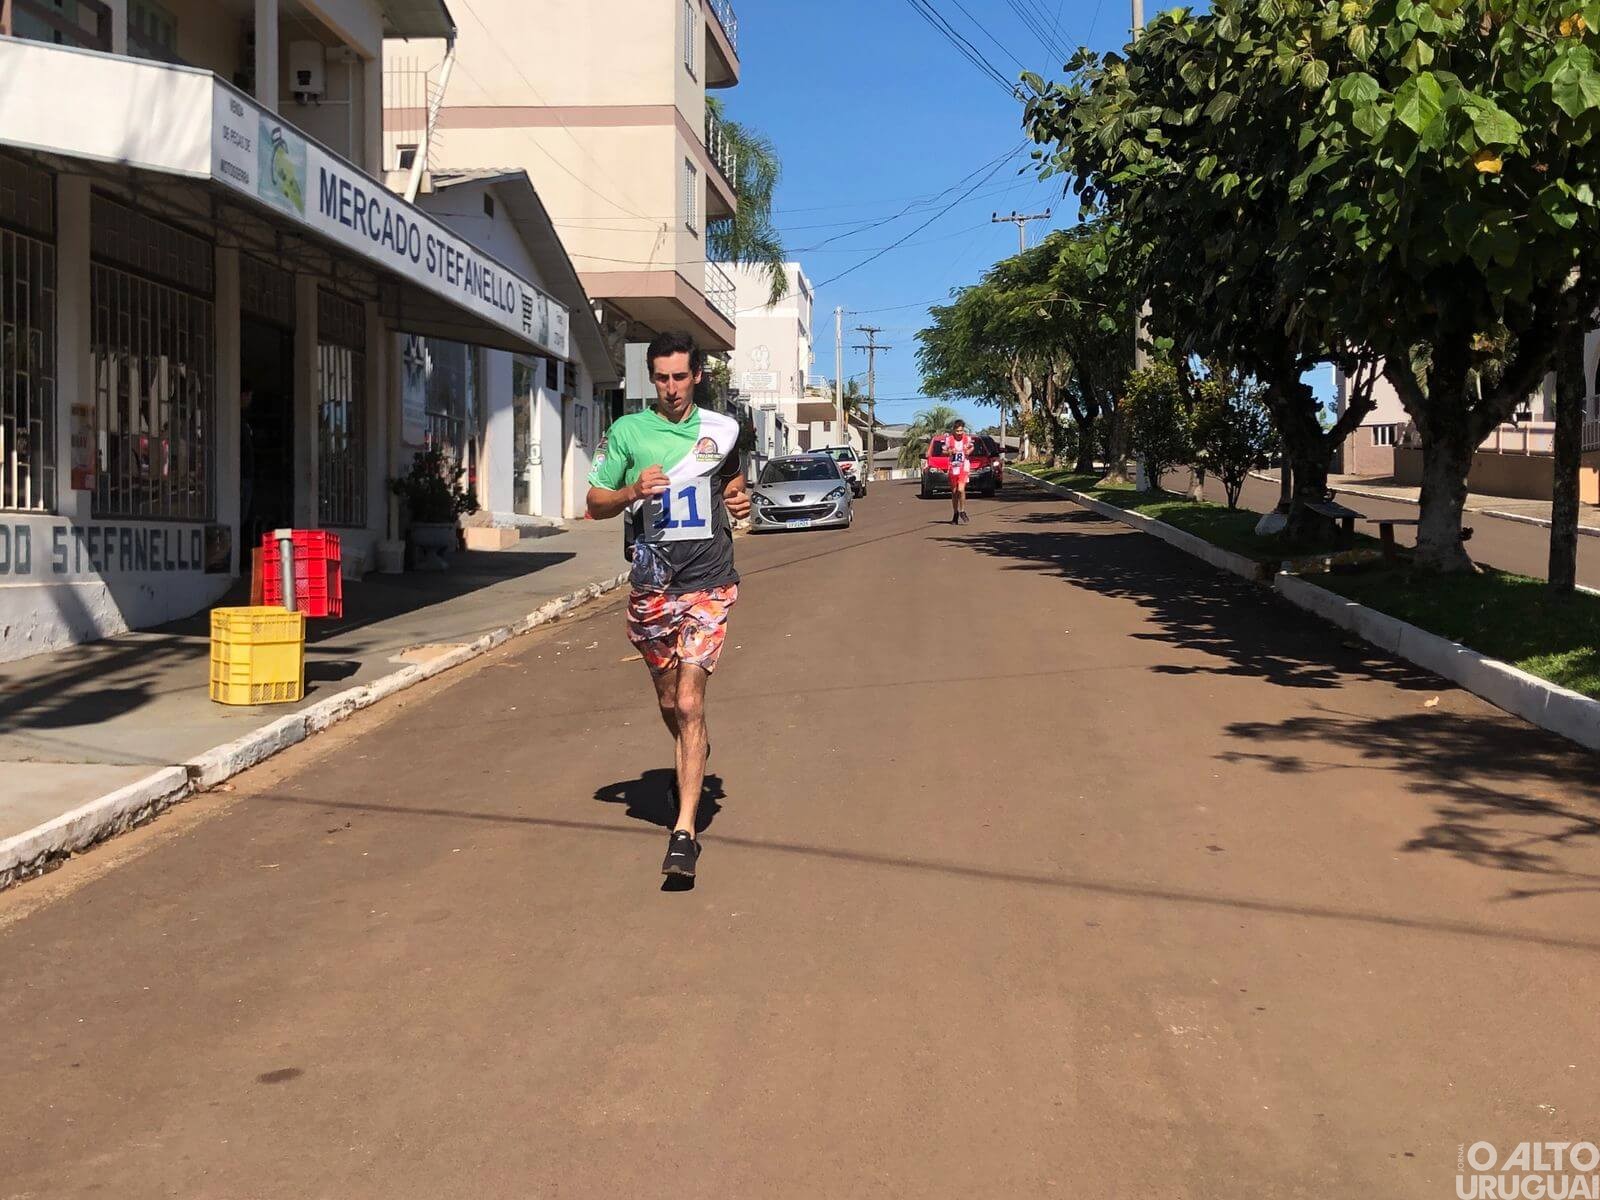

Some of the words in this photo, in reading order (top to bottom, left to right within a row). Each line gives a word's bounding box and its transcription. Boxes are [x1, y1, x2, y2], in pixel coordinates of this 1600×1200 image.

[320, 167, 421, 264] MERCADO
[426, 234, 516, 314] STEFANELLO
[653, 486, 706, 528] 11
[52, 526, 201, 574] STEFANELLO
